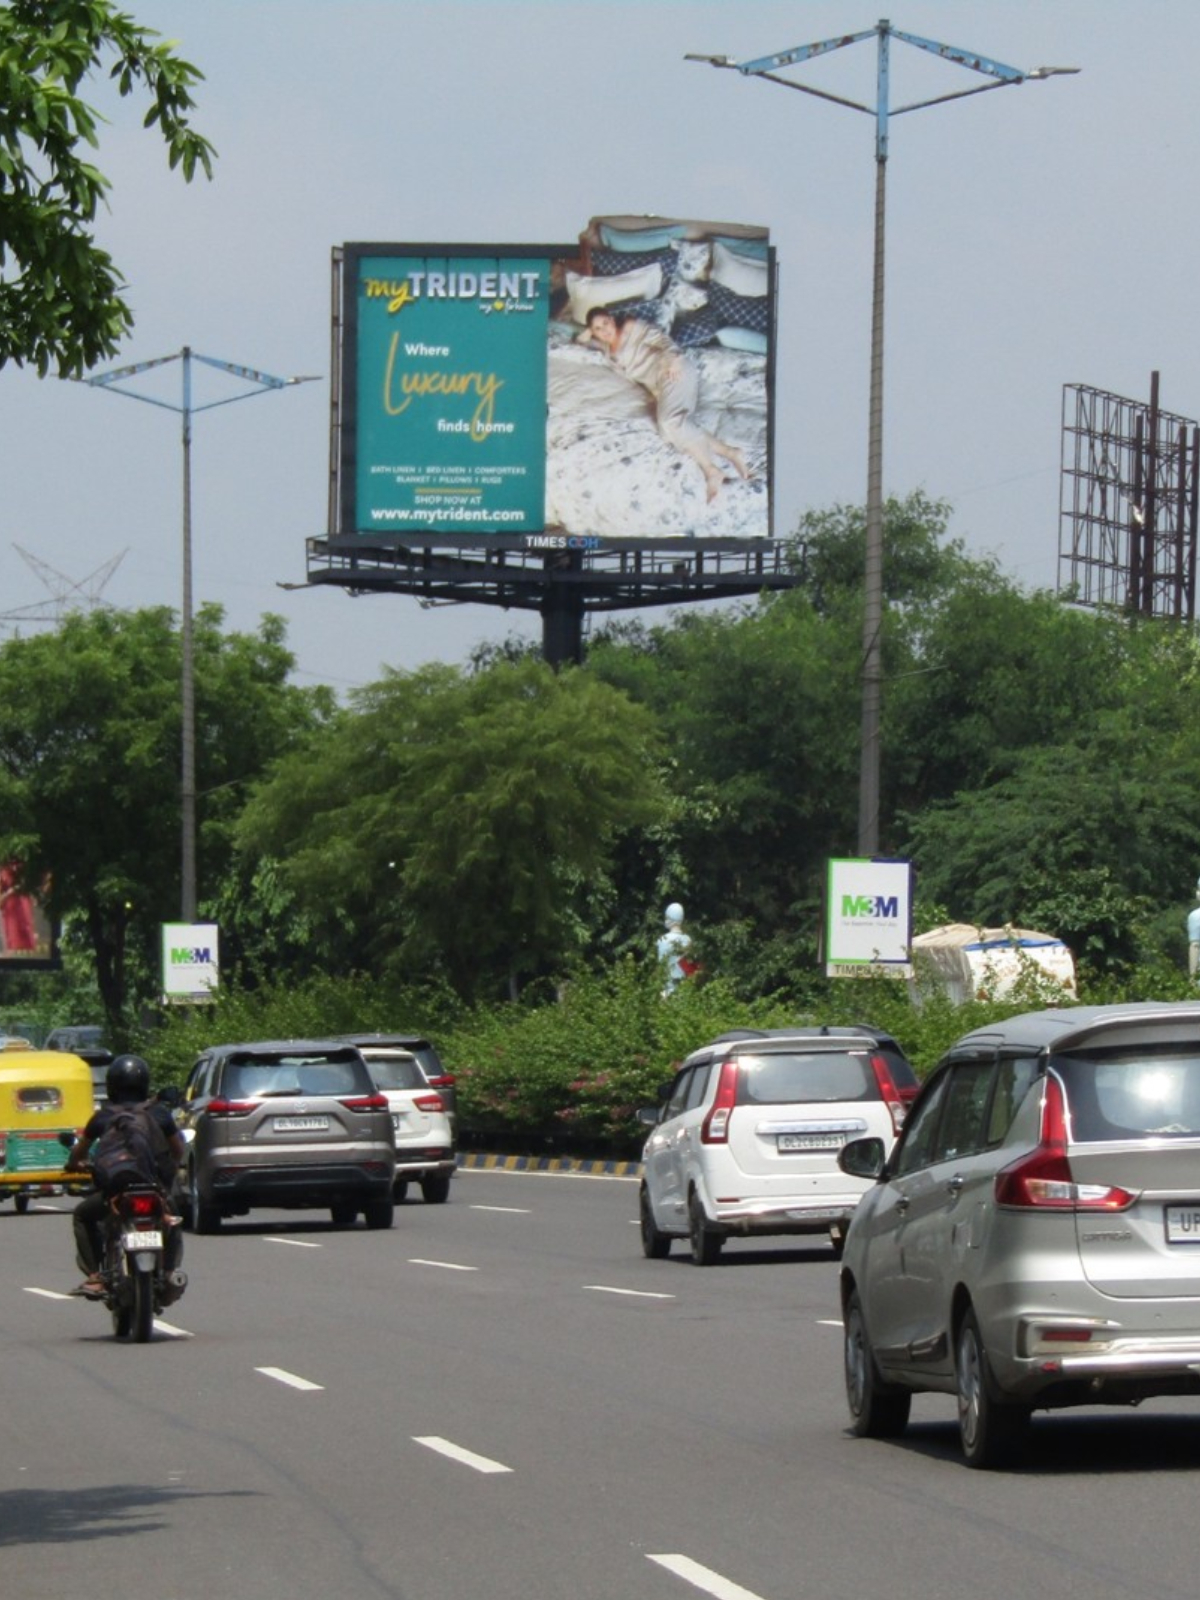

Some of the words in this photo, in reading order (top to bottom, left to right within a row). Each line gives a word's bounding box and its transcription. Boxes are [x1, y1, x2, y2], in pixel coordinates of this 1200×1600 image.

[404, 342, 450, 356] Where
[384, 331, 505, 441] Luxury
[437, 418, 470, 432] finds
[476, 420, 514, 433] home
[371, 466, 391, 474] BATH
[475, 467, 526, 475] COMFORTERS
[396, 475, 430, 483] BLANKET
[438, 476, 472, 484] PILLOWS
[414, 496, 442, 505] SHOP
[443, 496, 468, 505] NOW
[469, 496, 482, 505] AT
[371, 507, 525, 524] www.mytrident.com
[525, 536, 567, 548] TIMES
[841, 894, 898, 918] M3M
